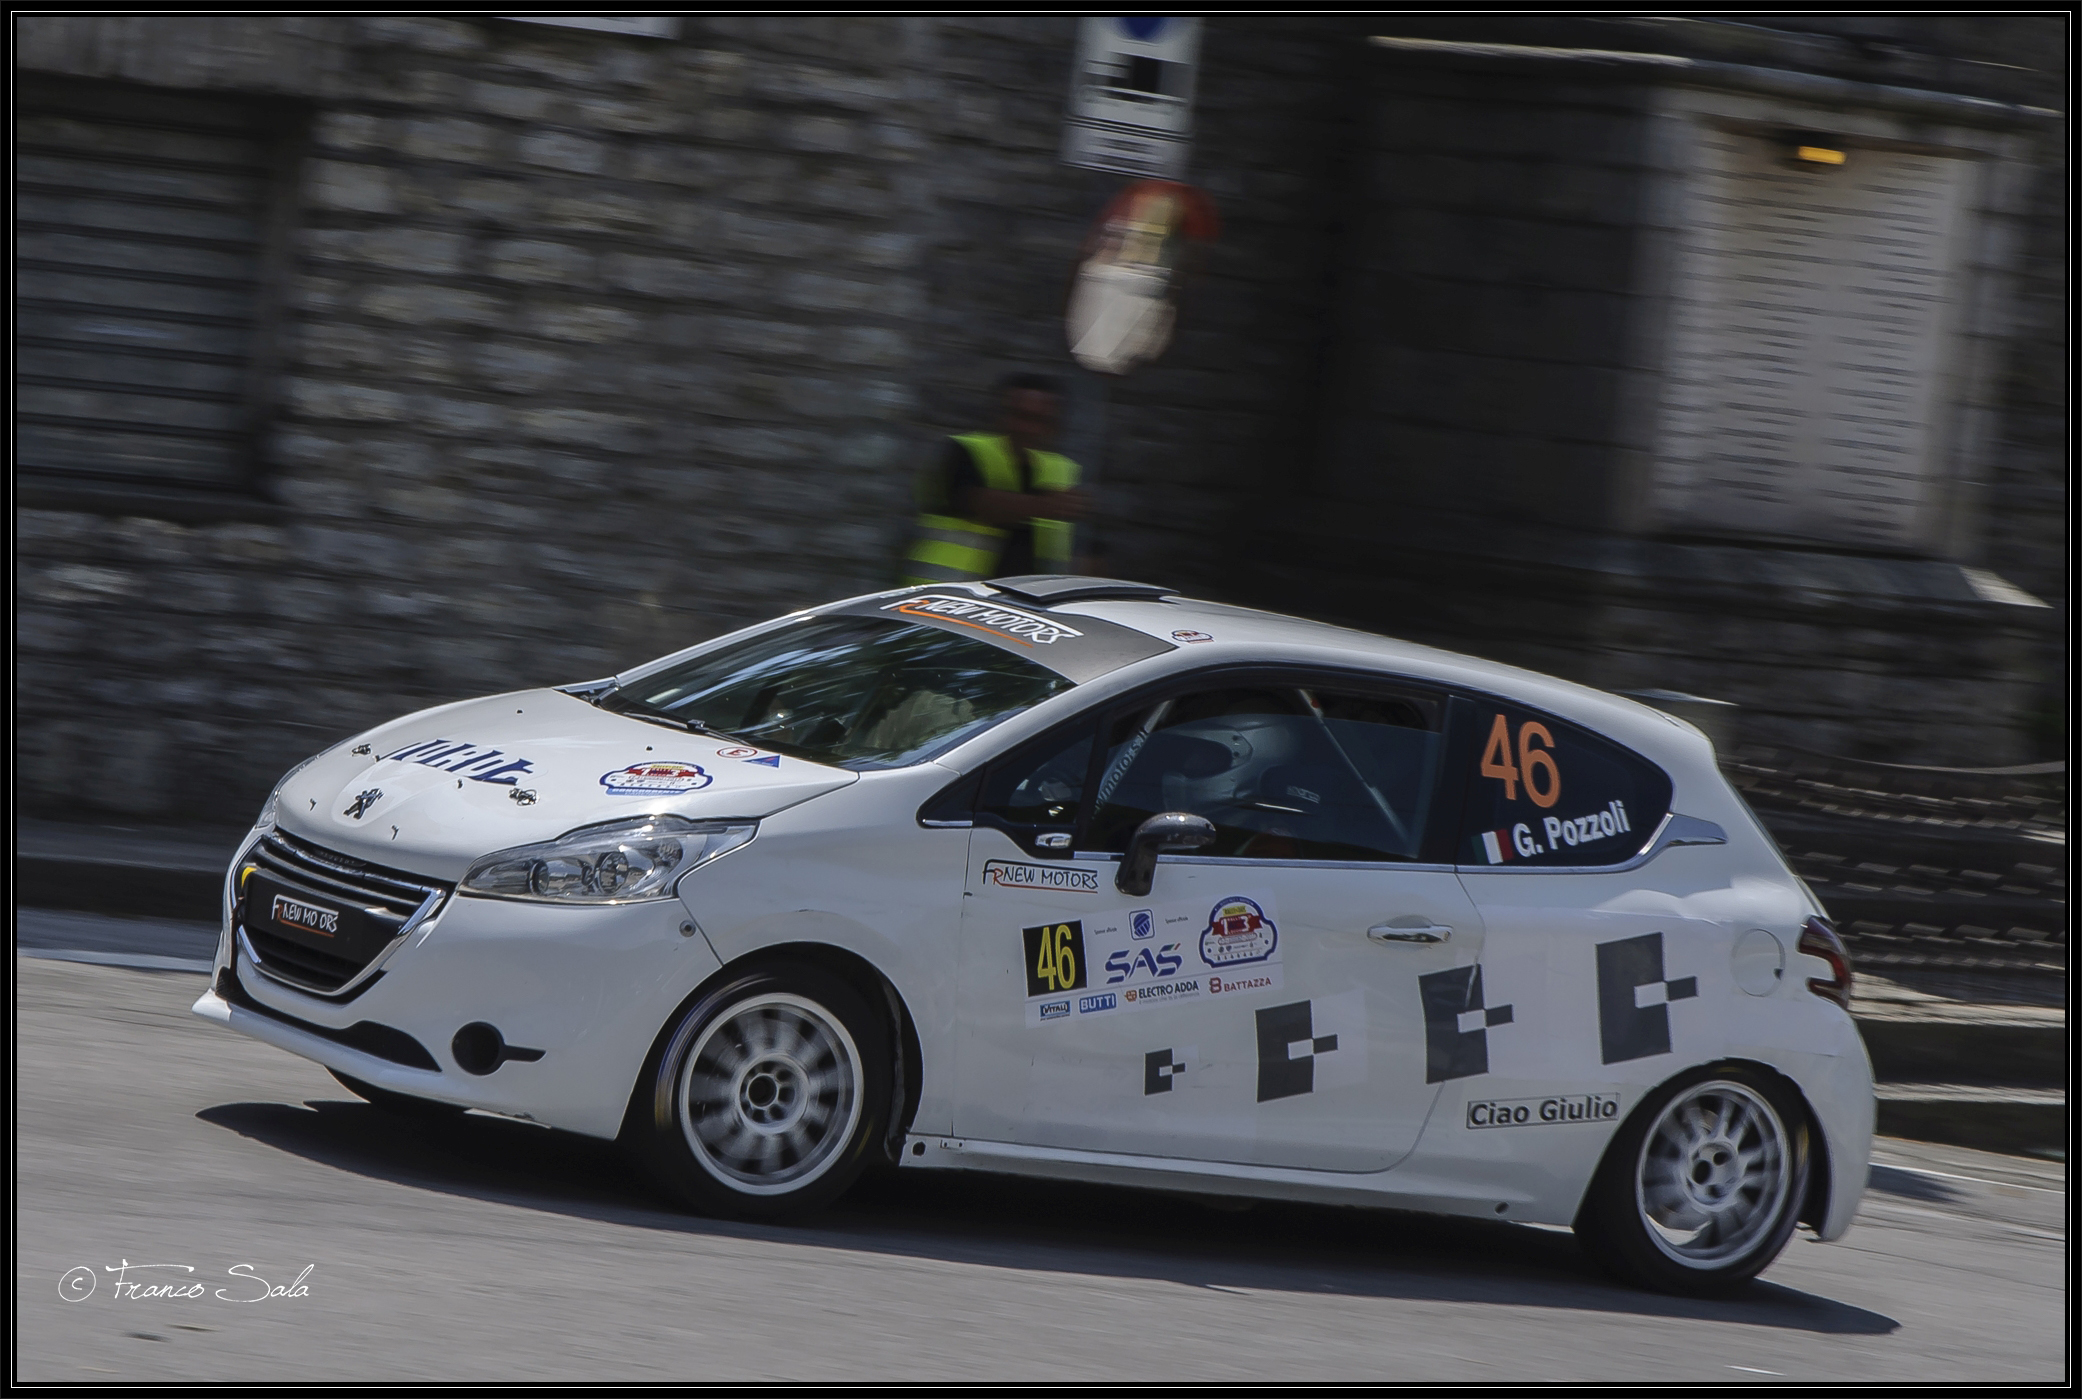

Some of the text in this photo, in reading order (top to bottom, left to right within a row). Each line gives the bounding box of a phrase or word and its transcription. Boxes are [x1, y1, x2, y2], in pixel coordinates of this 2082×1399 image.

[967, 608, 1076, 645] MOTORS
[1480, 713, 1561, 808] 46
[1512, 799, 1631, 858] G. Pozzoli
[1041, 868, 1098, 890] MOTORS
[1037, 924, 1076, 991] 46
[1105, 944, 1182, 984] SAS
[1138, 984, 1173, 999] ELECTRO
[1174, 980, 1199, 995] ADDA
[1223, 977, 1272, 992] BATTAZZA
[1081, 995, 1115, 1011] BUTTI
[1470, 1095, 1618, 1125] Ciao Giulio
